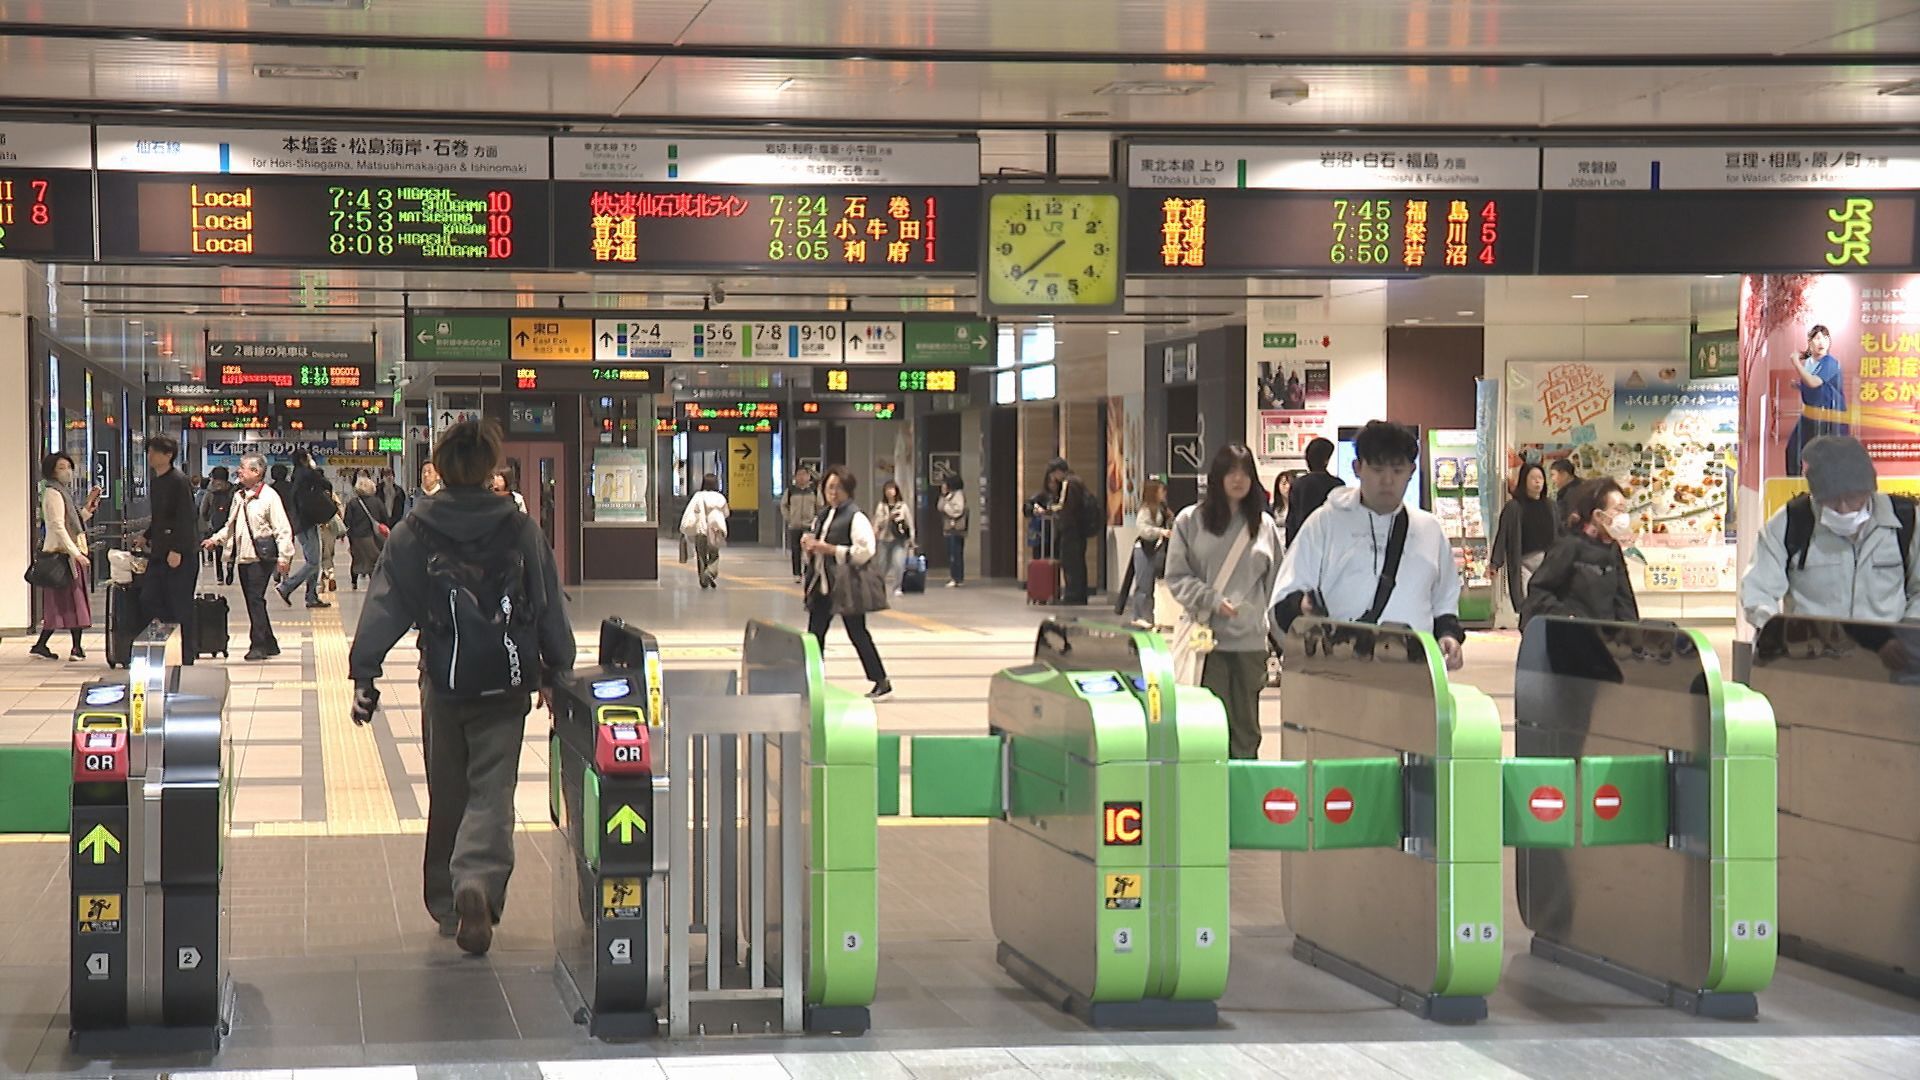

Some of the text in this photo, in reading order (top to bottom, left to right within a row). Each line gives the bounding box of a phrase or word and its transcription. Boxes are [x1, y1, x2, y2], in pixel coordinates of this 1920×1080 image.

[252, 158, 266, 168] for
[1141, 159, 1225, 172] 東北本線 上り
[1577, 160, 1617, 174] 常磐線
[1192, 175, 1216, 185] Line
[1604, 176, 1626, 188] Line
[32, 181, 48, 202] 7
[191, 184, 252, 207] Local
[329, 187, 393, 210] 7:43
[488, 191, 512, 213] 10
[590, 191, 749, 217] 快速仙石東北ライン
[769, 195, 828, 216] 7:24
[924, 196, 936, 218] 1
[32, 204, 49, 225] 8
[1026, 207, 1078, 220] 11 1
[1046, 203, 1063, 215] 12
[1163, 198, 1206, 223] 普通
[1333, 199, 1391, 220] 7:45
[1481, 201, 1496, 222] 4
[1828, 198, 1874, 222] JR
[192, 207, 253, 230] Local
[329, 211, 393, 233] 7:53
[488, 214, 513, 236] 10
[591, 214, 637, 239] 普通
[769, 218, 828, 239] 7:54
[924, 219, 936, 240] 1
[1009, 223, 1026, 235] 10
[1085, 221, 1097, 234] 2
[1162, 222, 1205, 246] 普通
[1332, 222, 1390, 243] 7:53
[1481, 222, 1496, 243] 5
[1827, 221, 1873, 244] JR
[193, 230, 253, 253] Local
[329, 233, 394, 256] 8:08
[488, 236, 512, 259] 10
[1001, 243, 1104, 256] 9 3
[591, 239, 637, 261] 普通
[769, 240, 829, 261] 8:05
[924, 241, 936, 262] 1
[1162, 244, 1204, 266] 普通
[1330, 244, 1389, 264] 6:50
[1479, 244, 1495, 265] 4
[1825, 242, 1870, 265] JR
[1010, 265, 1094, 279] 8 4
[1028, 279, 1079, 296] 7 6 5
[533, 323, 560, 335] 東口
[614, 746, 641, 761] QR
[85, 754, 114, 770] QR
[1105, 807, 1141, 842] IC
[1119, 931, 1128, 944] 3
[1200, 931, 1208, 943] 4
[1462, 927, 1471, 938] 4
[617, 942, 626, 954] 2
[847, 935, 856, 948] 3
[95, 957, 102, 970] 1
[183, 952, 192, 964] 2
